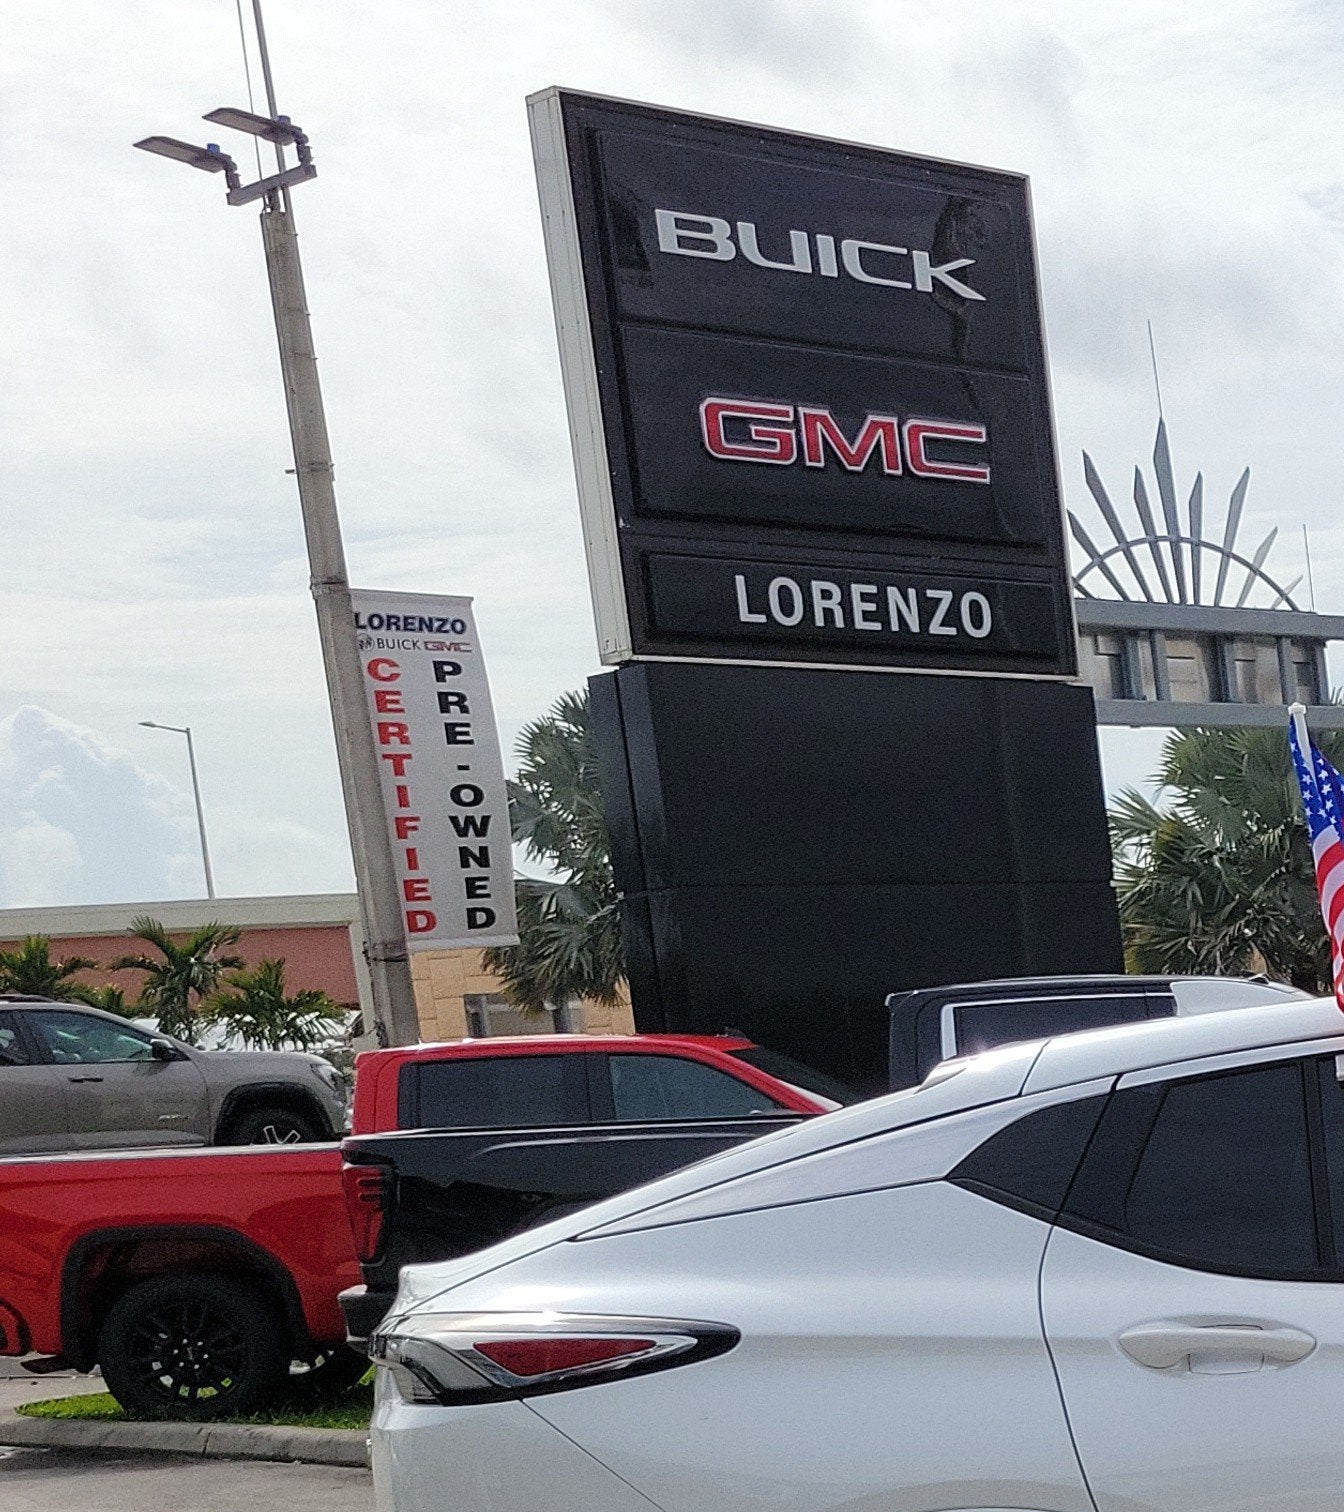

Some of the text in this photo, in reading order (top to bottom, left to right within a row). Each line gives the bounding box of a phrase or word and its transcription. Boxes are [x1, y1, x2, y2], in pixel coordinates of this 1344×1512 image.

[655, 208, 987, 301] BUICK
[701, 396, 991, 484] GMC
[354, 611, 467, 635] LORENZO
[376, 638, 472, 653] BUICK GMC
[734, 574, 992, 639] LORENZO
[367, 657, 437, 934] CERTIFIED
[433, 660, 497, 930] PRE-OWNED
